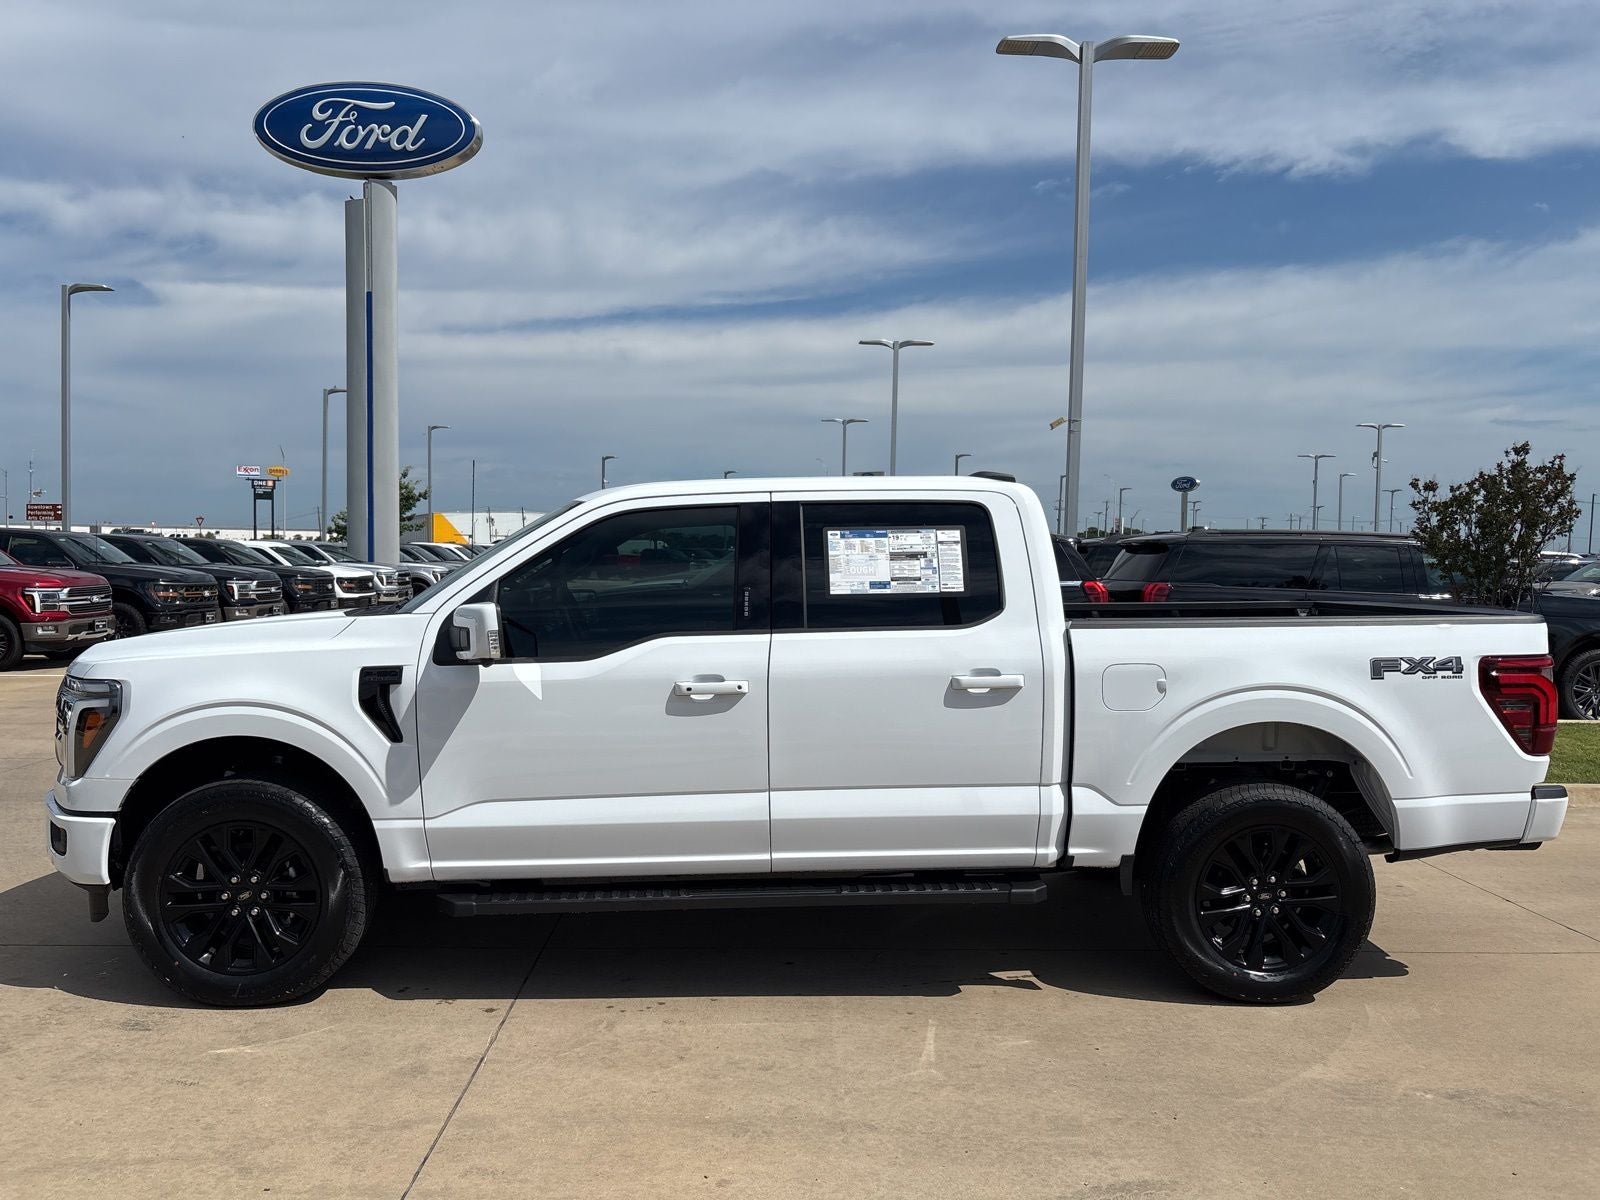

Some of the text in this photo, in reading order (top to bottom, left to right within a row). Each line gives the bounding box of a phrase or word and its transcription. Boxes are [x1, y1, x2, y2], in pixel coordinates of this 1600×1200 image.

[299, 97, 428, 152] Ford
[237, 466, 260, 474] Exxon
[1176, 479, 1191, 488] Ford
[1370, 656, 1464, 680] FX4
